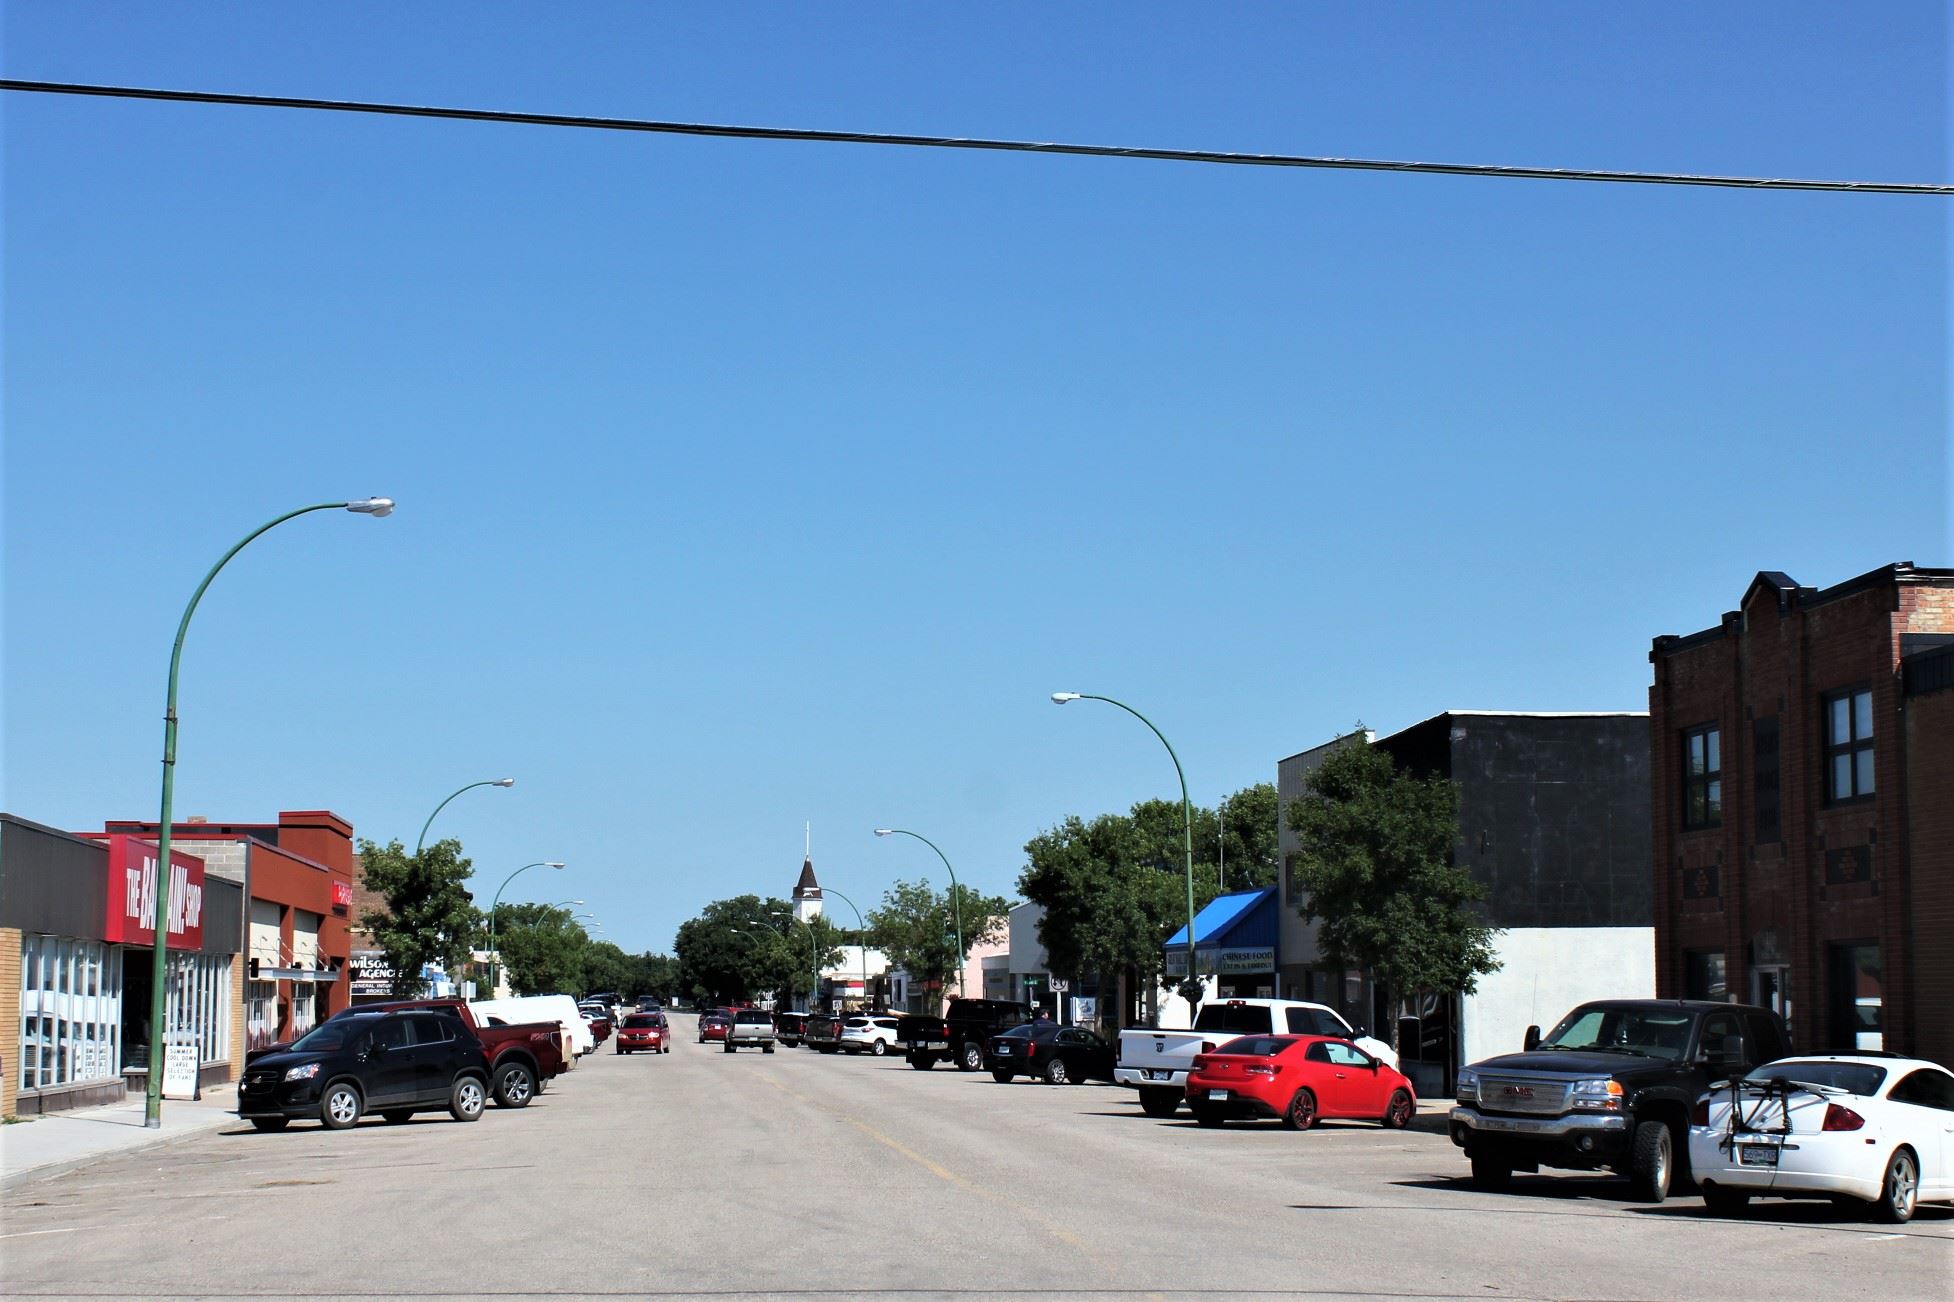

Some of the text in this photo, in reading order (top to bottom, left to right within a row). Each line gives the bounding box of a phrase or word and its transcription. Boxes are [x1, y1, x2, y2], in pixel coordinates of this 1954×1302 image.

[126, 855, 202, 935] THE BAAIN! SHOP
[1252, 951, 1273, 960] FOOD
